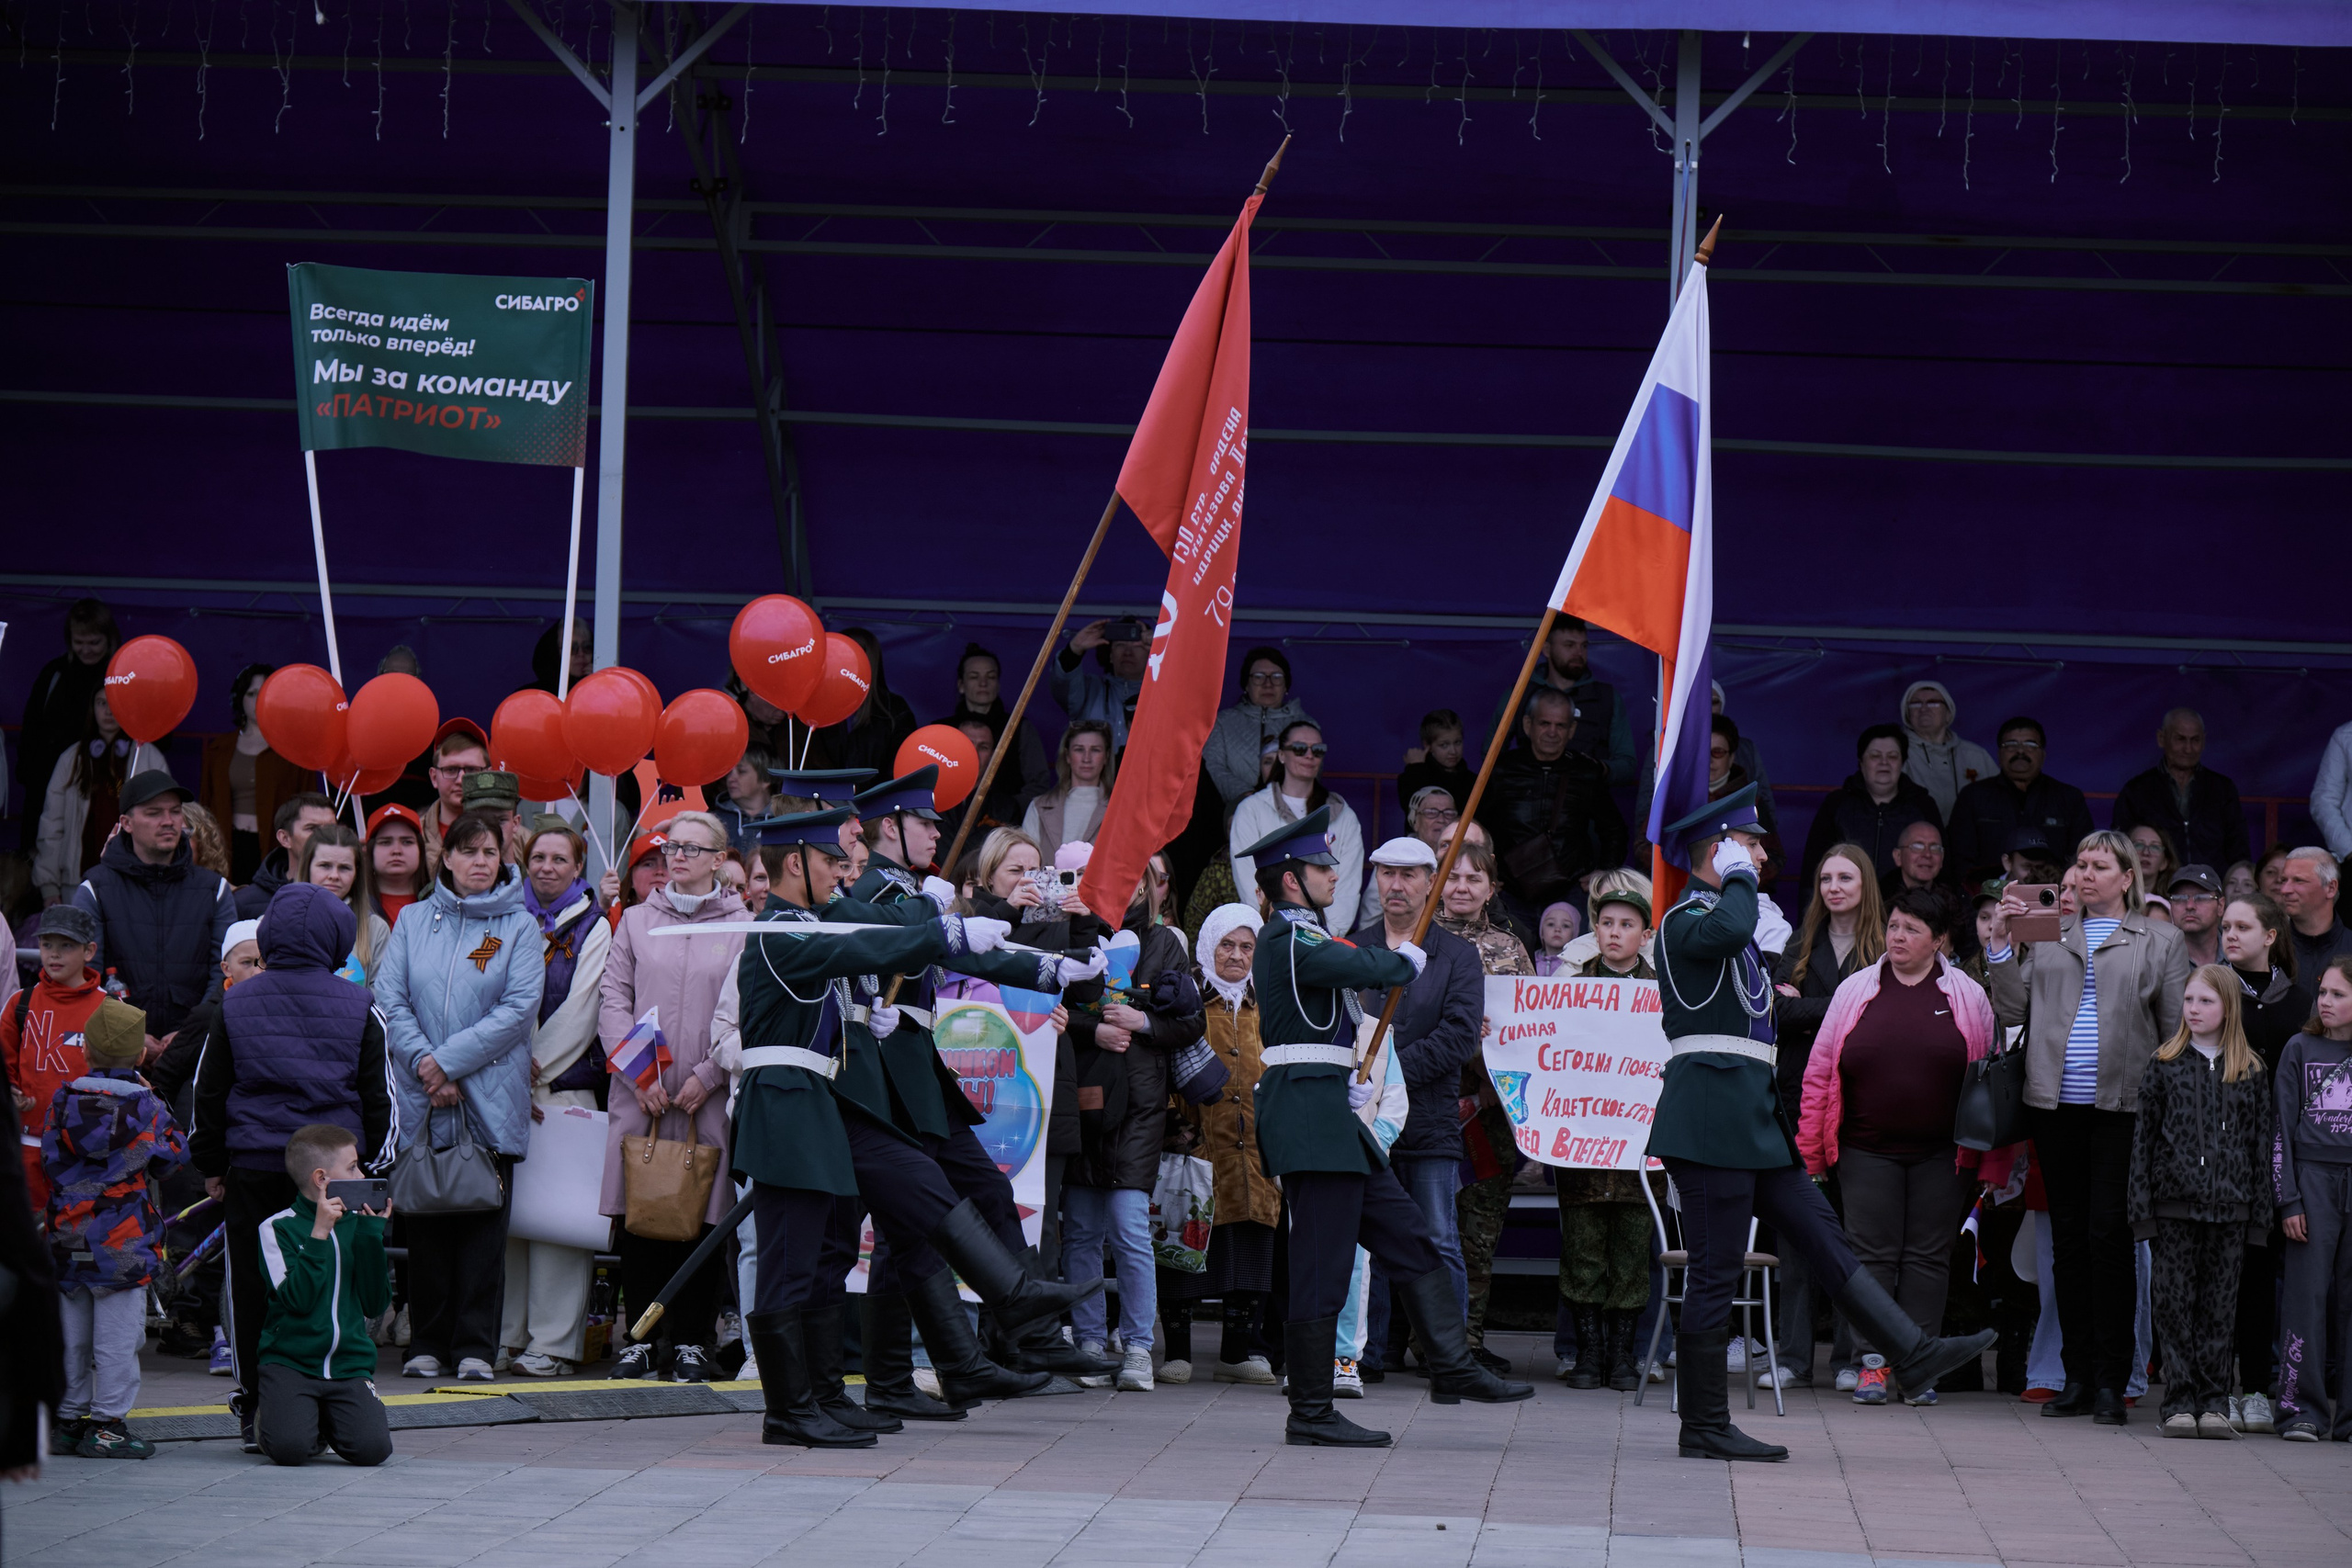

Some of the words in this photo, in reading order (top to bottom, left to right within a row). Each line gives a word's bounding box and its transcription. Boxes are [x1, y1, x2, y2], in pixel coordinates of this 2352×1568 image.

[495, 294, 579, 311] СИБАГРО
[310, 303, 383, 327] Всегда
[390, 312, 449, 333] идём
[311, 327, 381, 348] только
[386, 335, 476, 357] вперёд!
[313, 358, 364, 384] Мы
[371, 367, 408, 389] за
[417, 374, 571, 406] команду
[316, 393, 502, 430] «ПАТРИОТ»
[1210, 406, 1242, 476] ОРДЕНА
[1192, 470, 1236, 558] КУТУЗОВА
[1193, 518, 1236, 586] ИДРИЦК.
[768, 645, 812, 664] СИБАГРО
[840, 668, 867, 692] СИБАГРО
[918, 744, 954, 768] СИБАГРО
[1514, 978, 1620, 1013] КОМАНДА
[1618, 1057, 1664, 1081] ПОВЕЗ
